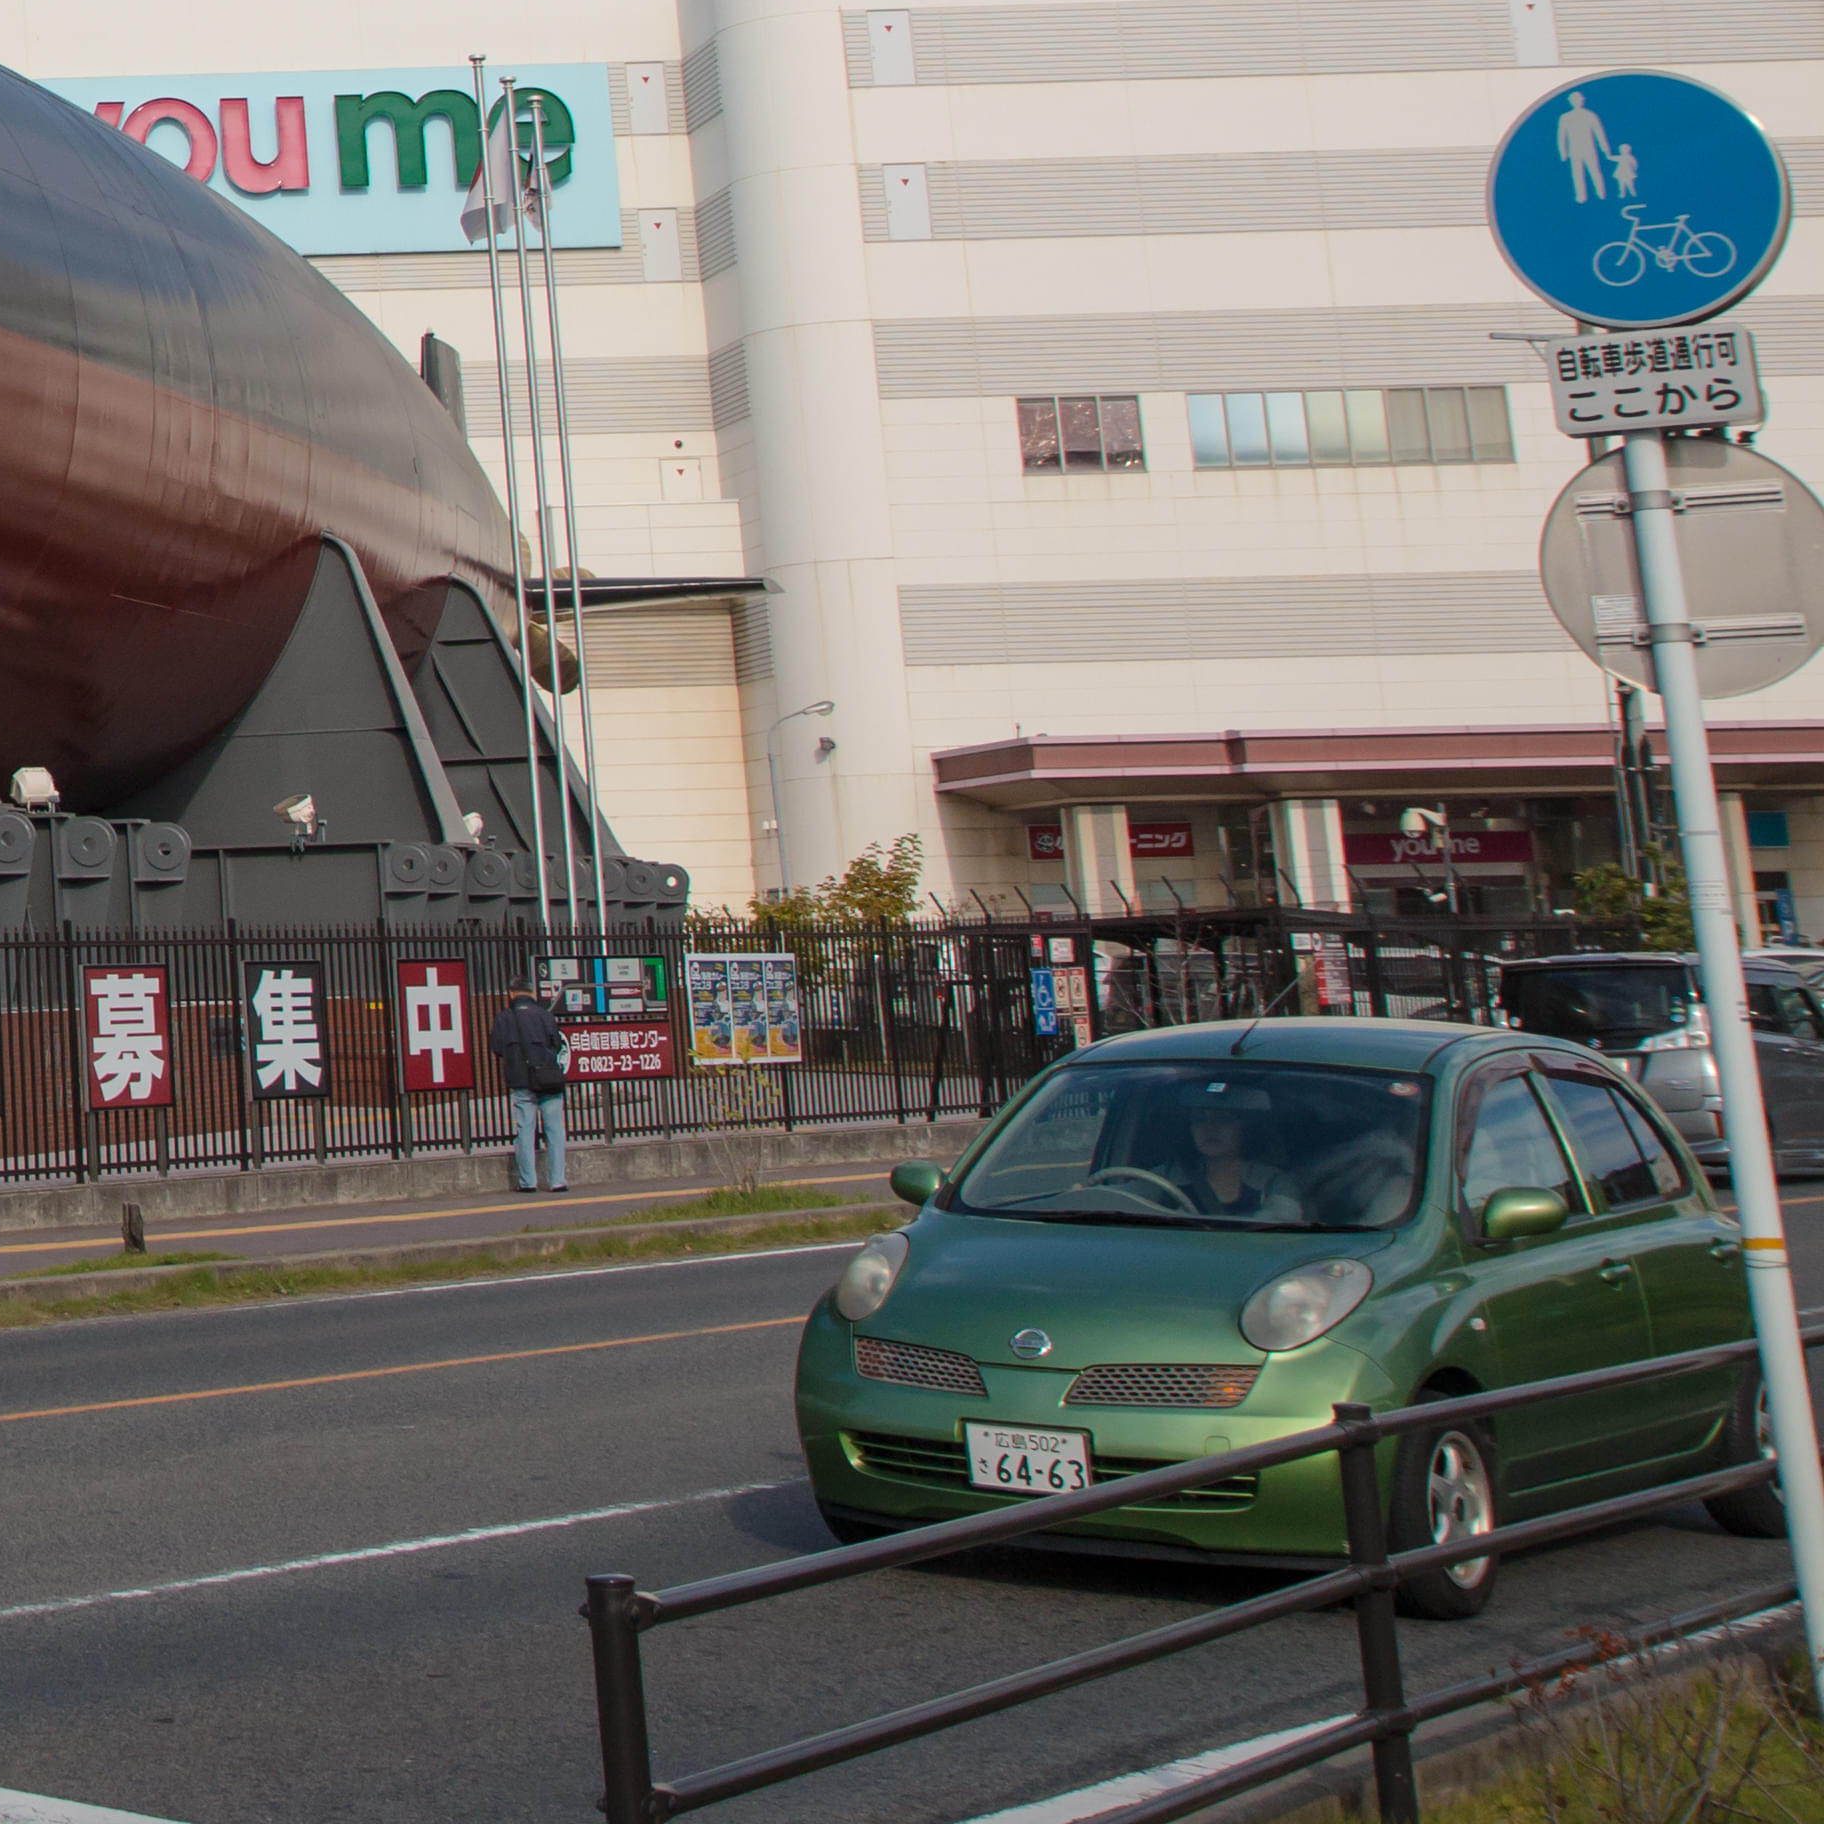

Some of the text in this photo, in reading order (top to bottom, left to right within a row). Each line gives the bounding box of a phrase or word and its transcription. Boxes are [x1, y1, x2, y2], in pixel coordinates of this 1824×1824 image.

[1557, 332, 1737, 382] 自転車歩道通行可
[1569, 378, 1741, 422] ここから
[570, 1030, 667, 1052] 呉自衛官募集センター
[996, 1453, 1084, 1490] 64-63
